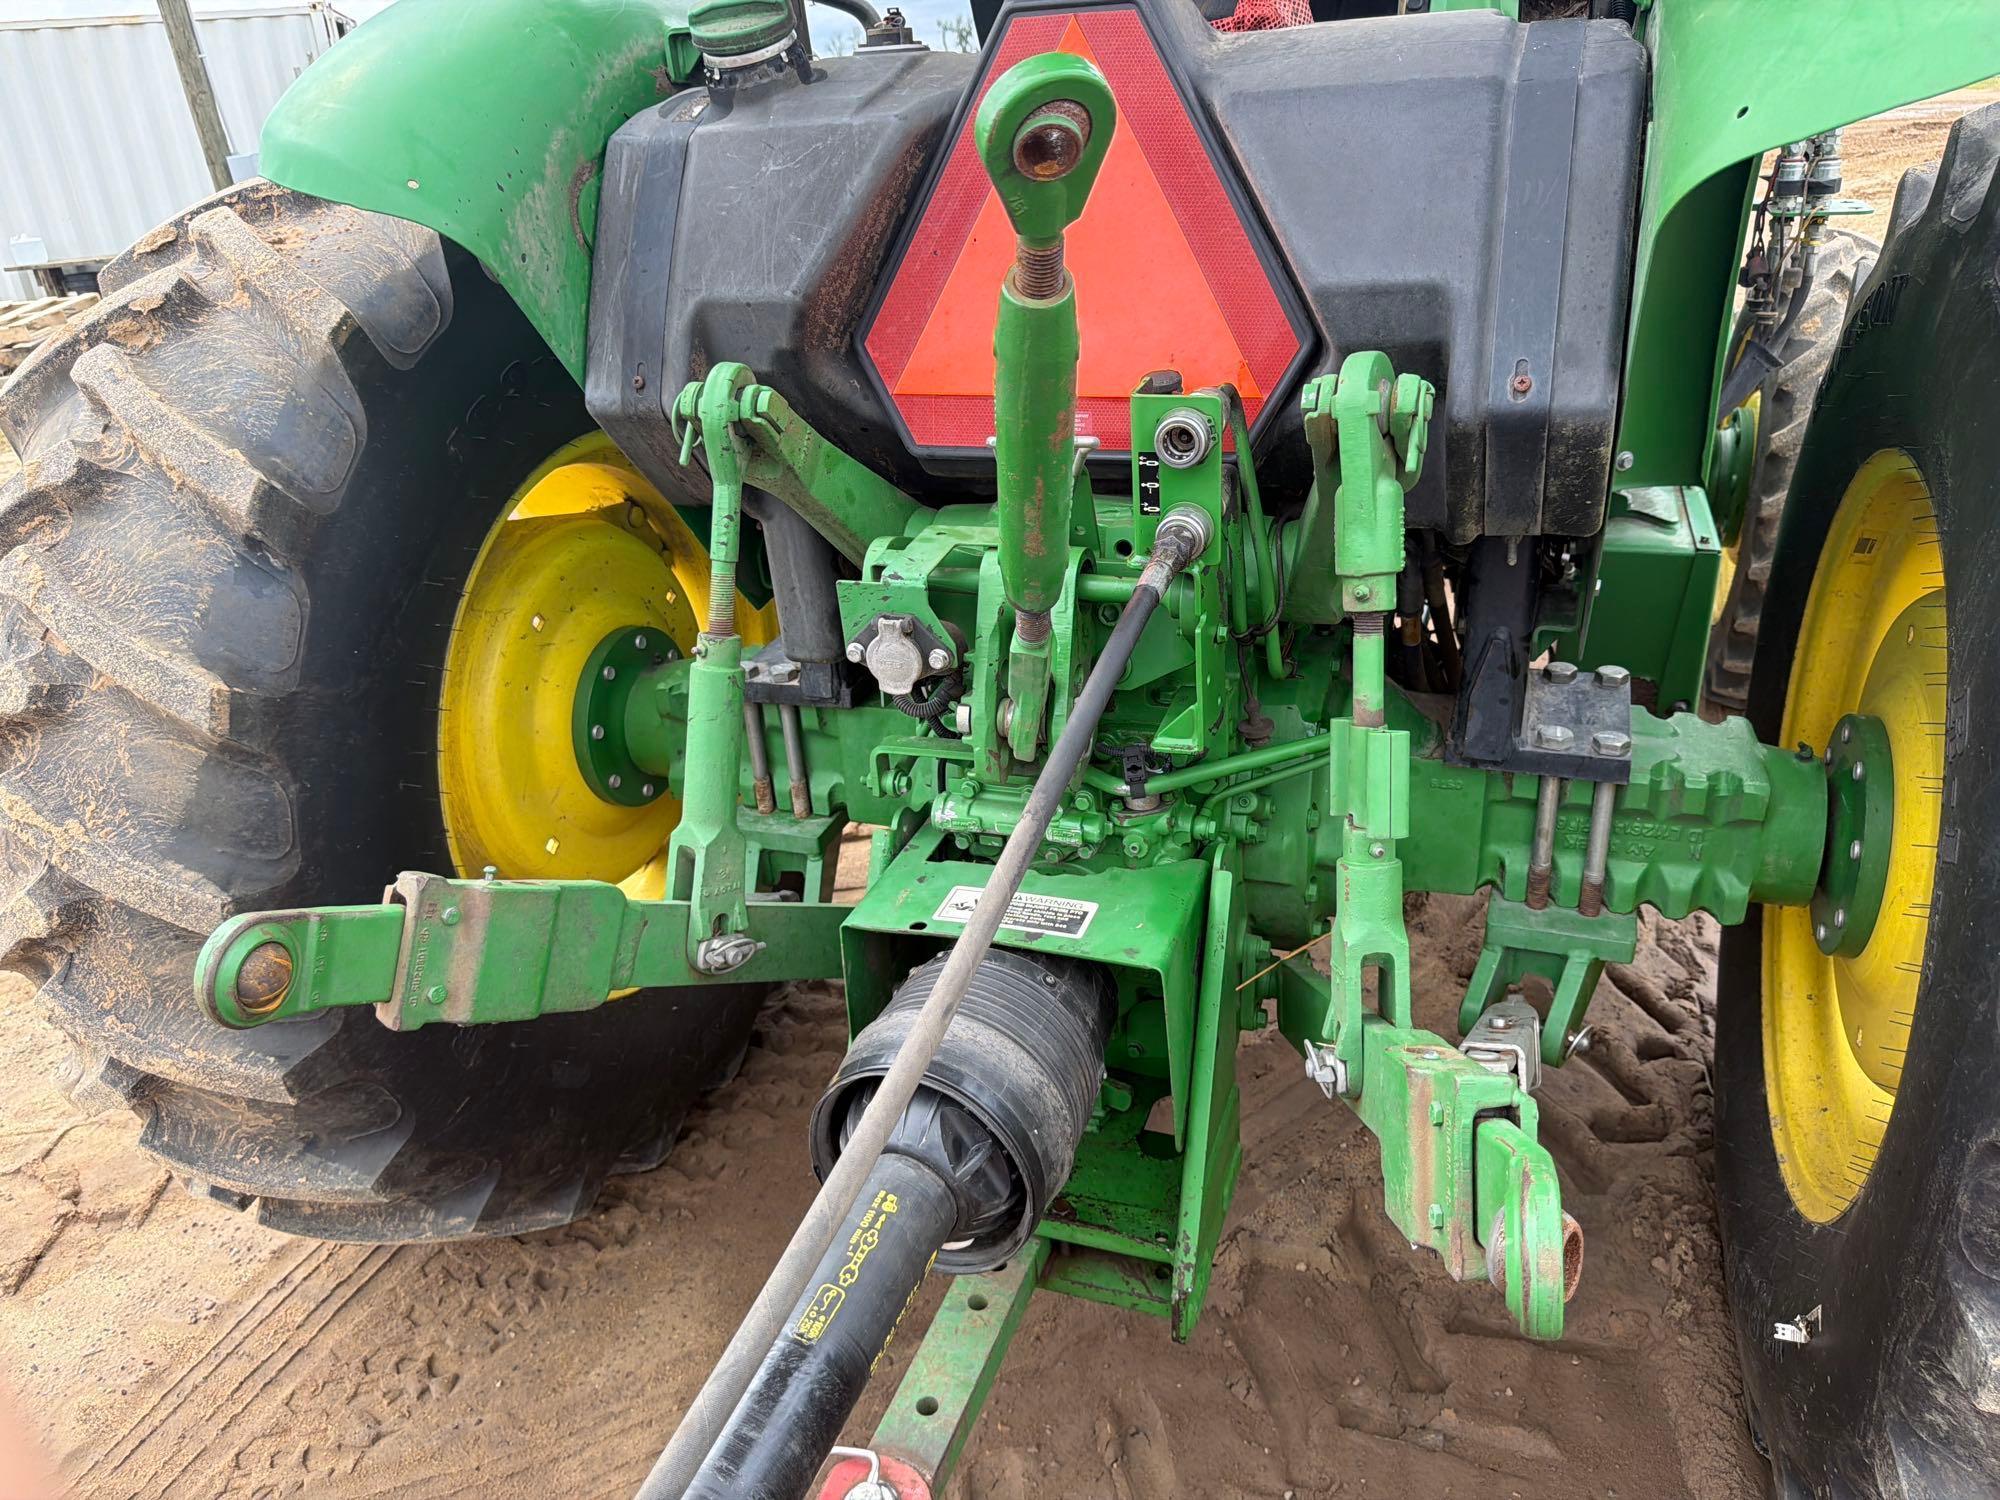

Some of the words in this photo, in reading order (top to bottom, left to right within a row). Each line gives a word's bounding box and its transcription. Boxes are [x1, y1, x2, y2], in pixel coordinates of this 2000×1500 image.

[1025, 896, 1084, 908] WARNING
[1025, 902, 1049, 910] INJURY
[860, 1209, 876, 1228] 1100
